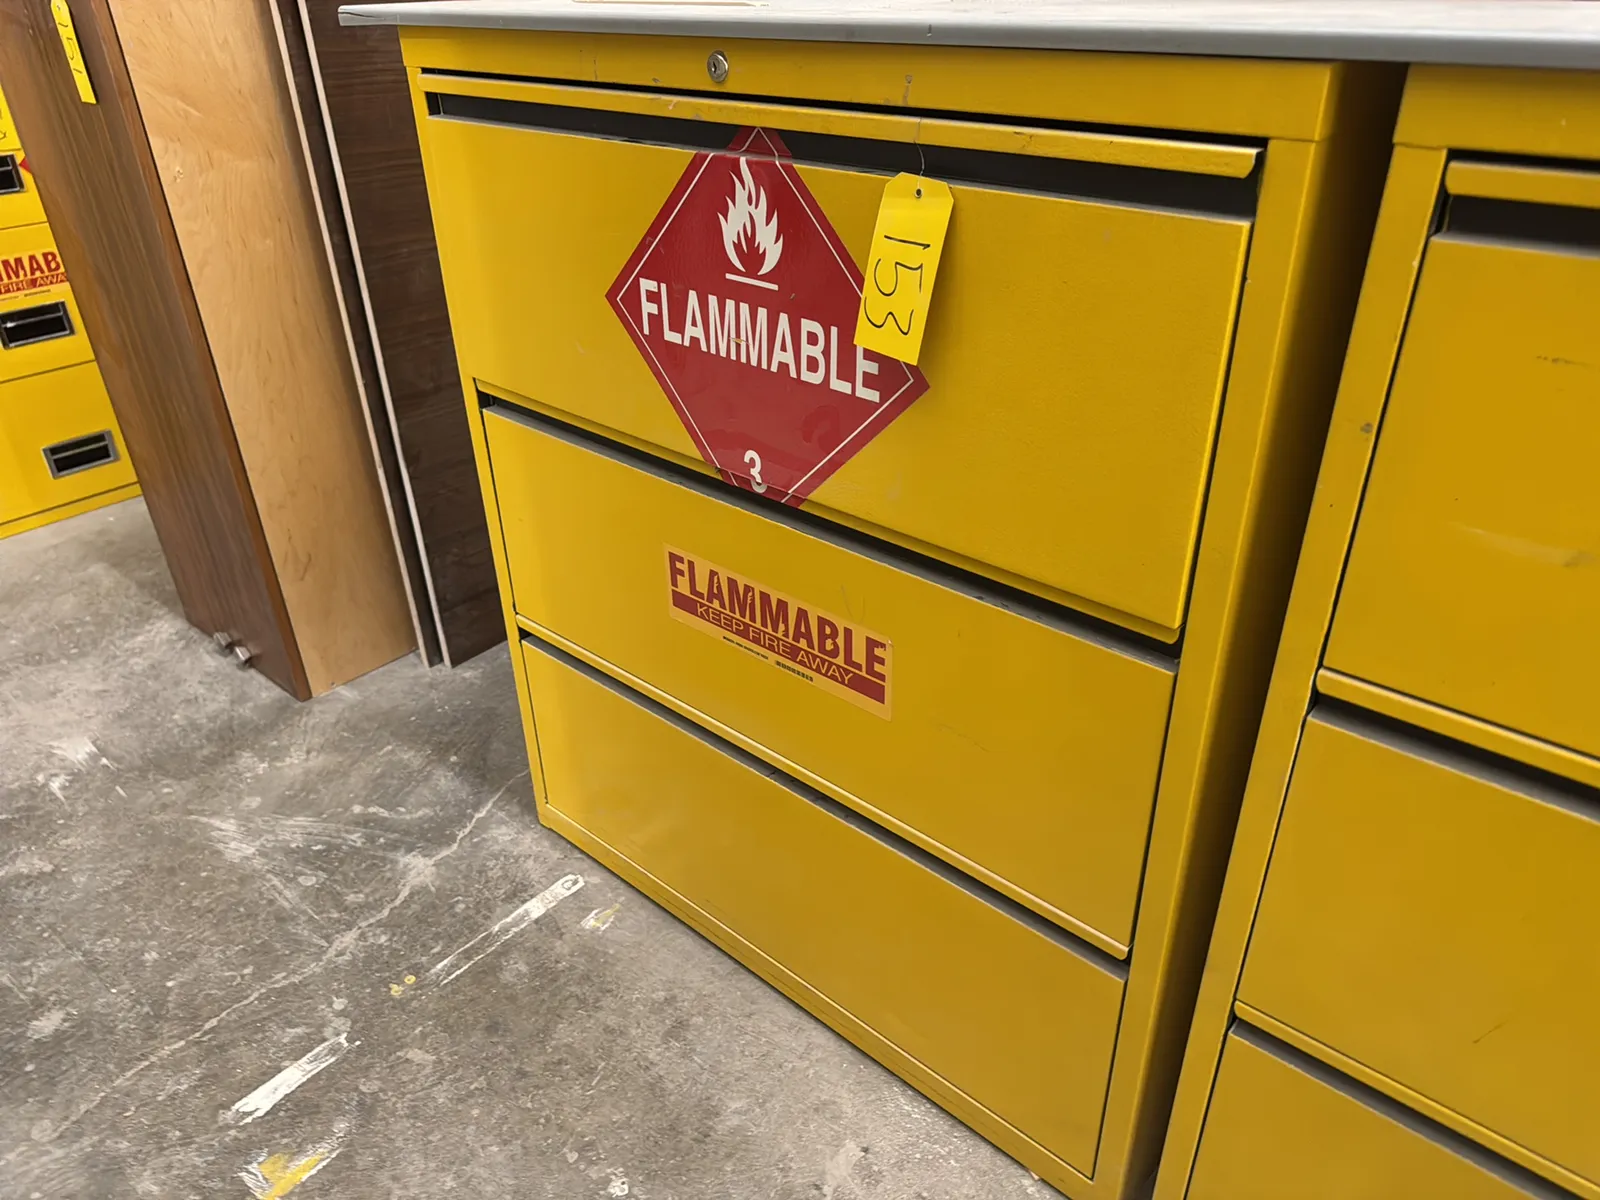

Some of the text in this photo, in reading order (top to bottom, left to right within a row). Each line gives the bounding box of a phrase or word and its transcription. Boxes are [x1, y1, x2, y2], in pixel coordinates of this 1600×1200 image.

[0, 251, 61, 283] MAB
[863, 234, 931, 336] 153
[639, 277, 880, 403] FLAMMABLE
[743, 449, 768, 494] 3
[668, 551, 887, 683] FLAMMABLE
[696, 602, 744, 633] KEEP
[749, 627, 792, 659] FIRE
[796, 650, 854, 685] AWAY
